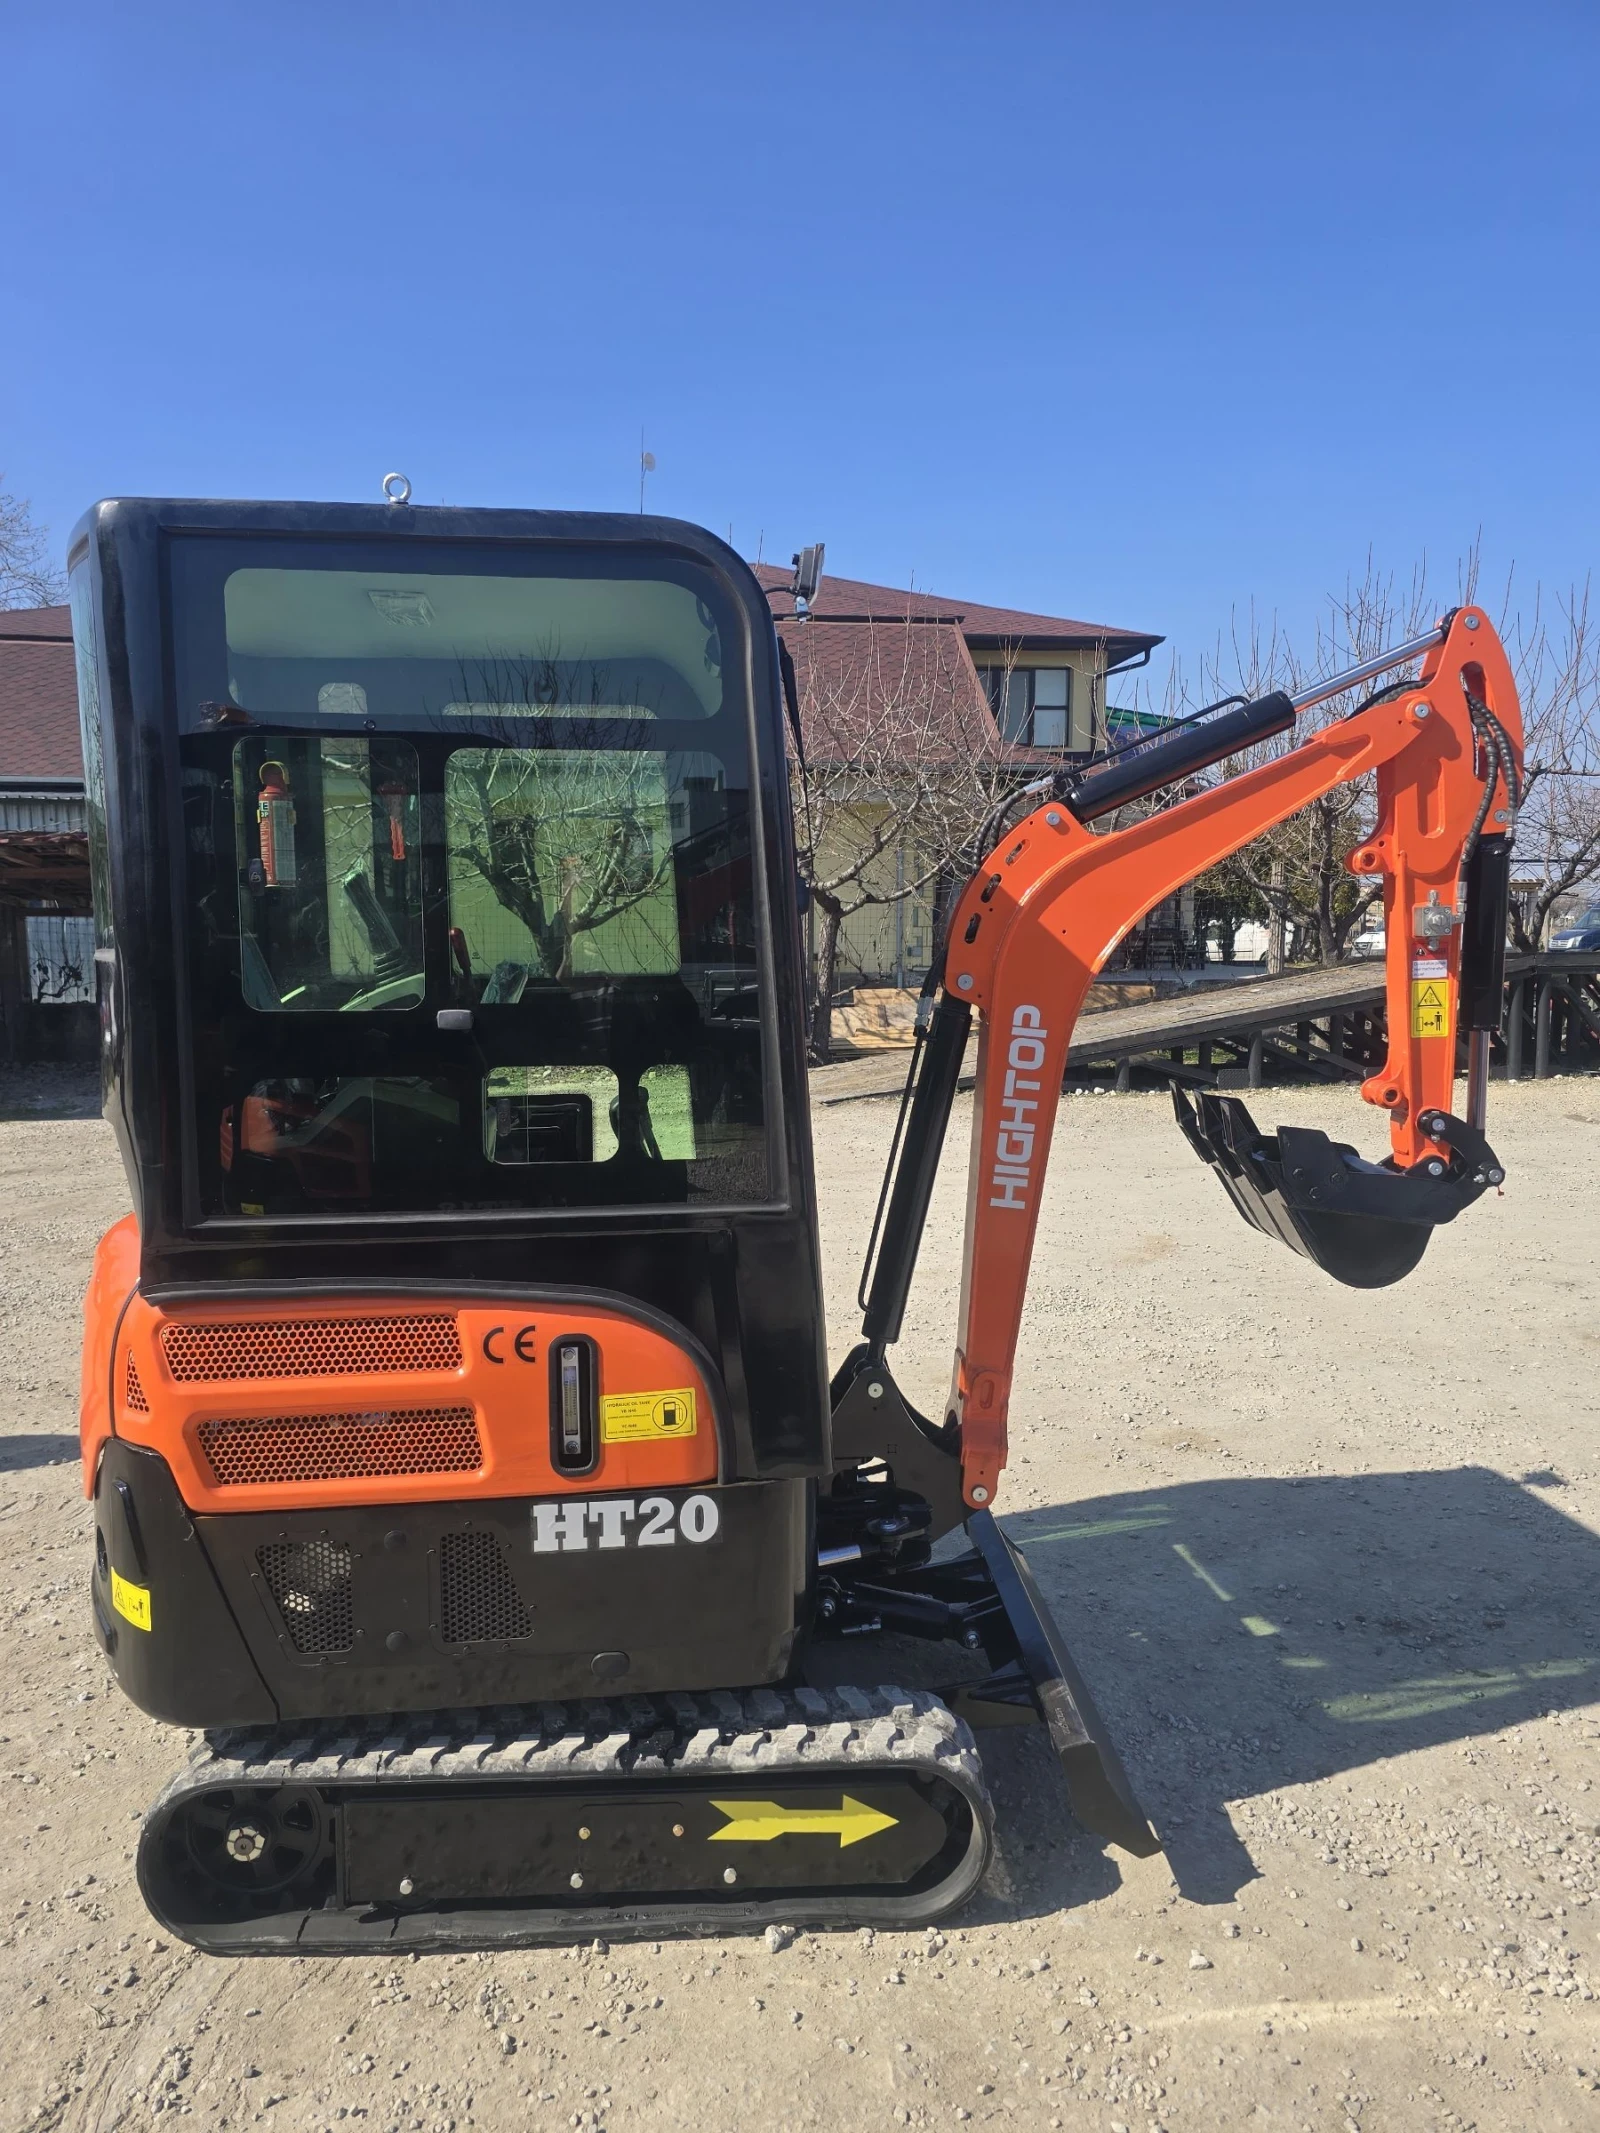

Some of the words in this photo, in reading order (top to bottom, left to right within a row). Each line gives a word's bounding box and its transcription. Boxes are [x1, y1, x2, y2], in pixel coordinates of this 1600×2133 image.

[990, 1005, 1047, 1209] HIGHTOP
[483, 1325, 536, 1364] CE
[533, 1495, 719, 1552] HT20
